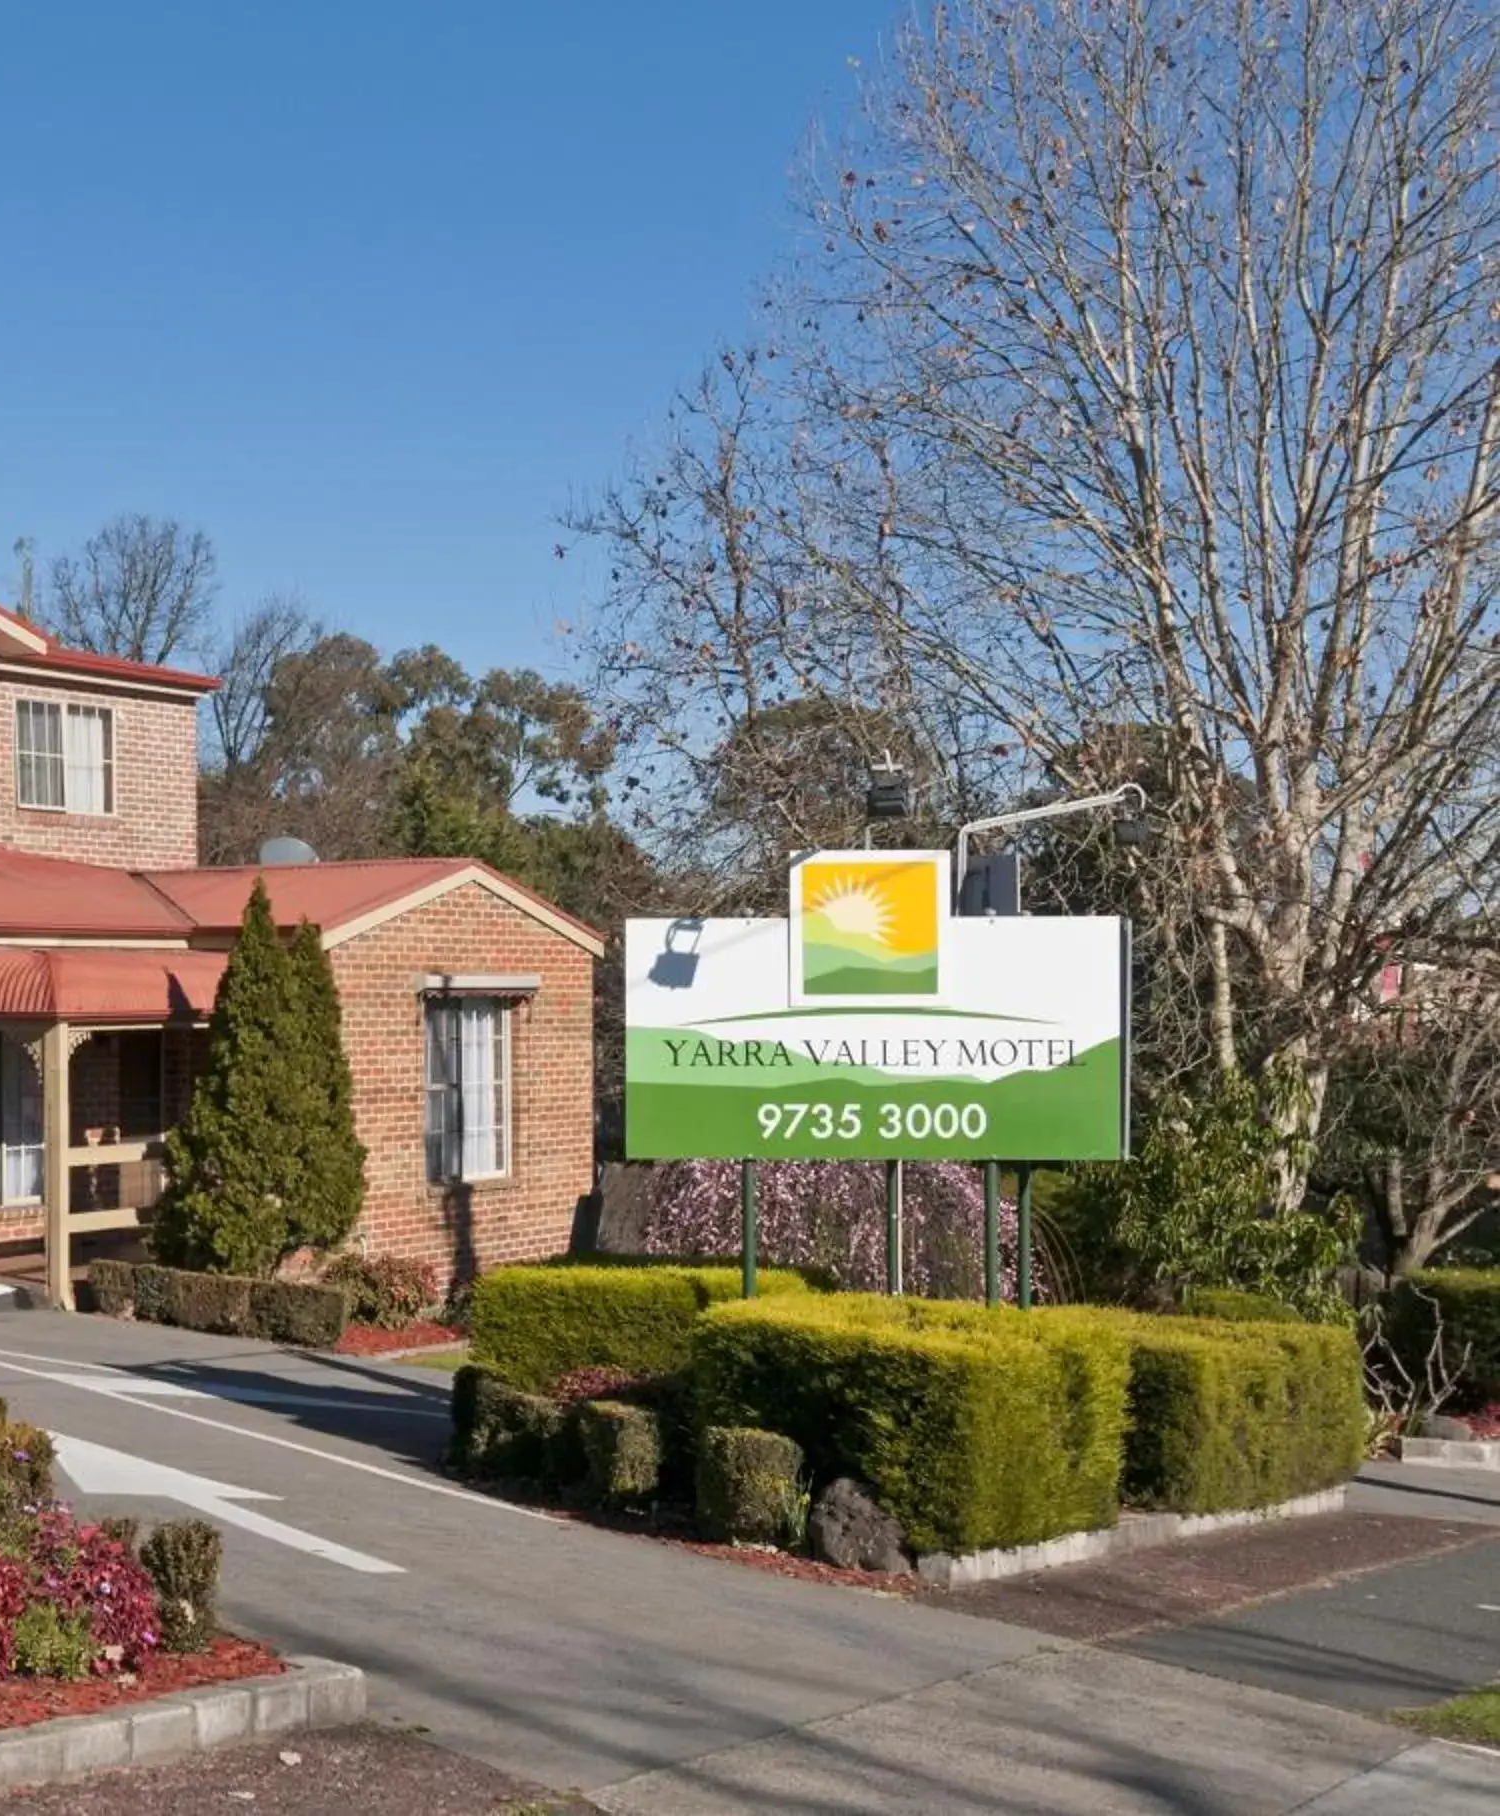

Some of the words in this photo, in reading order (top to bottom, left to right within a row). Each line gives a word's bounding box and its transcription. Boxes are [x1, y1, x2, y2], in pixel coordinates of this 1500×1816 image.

[662, 1039, 794, 1067] YARRA
[802, 1039, 948, 1067] VALLEY
[957, 1039, 1088, 1067] MOTEL
[756, 1103, 862, 1140] 9735
[878, 1103, 988, 1140] 3000
